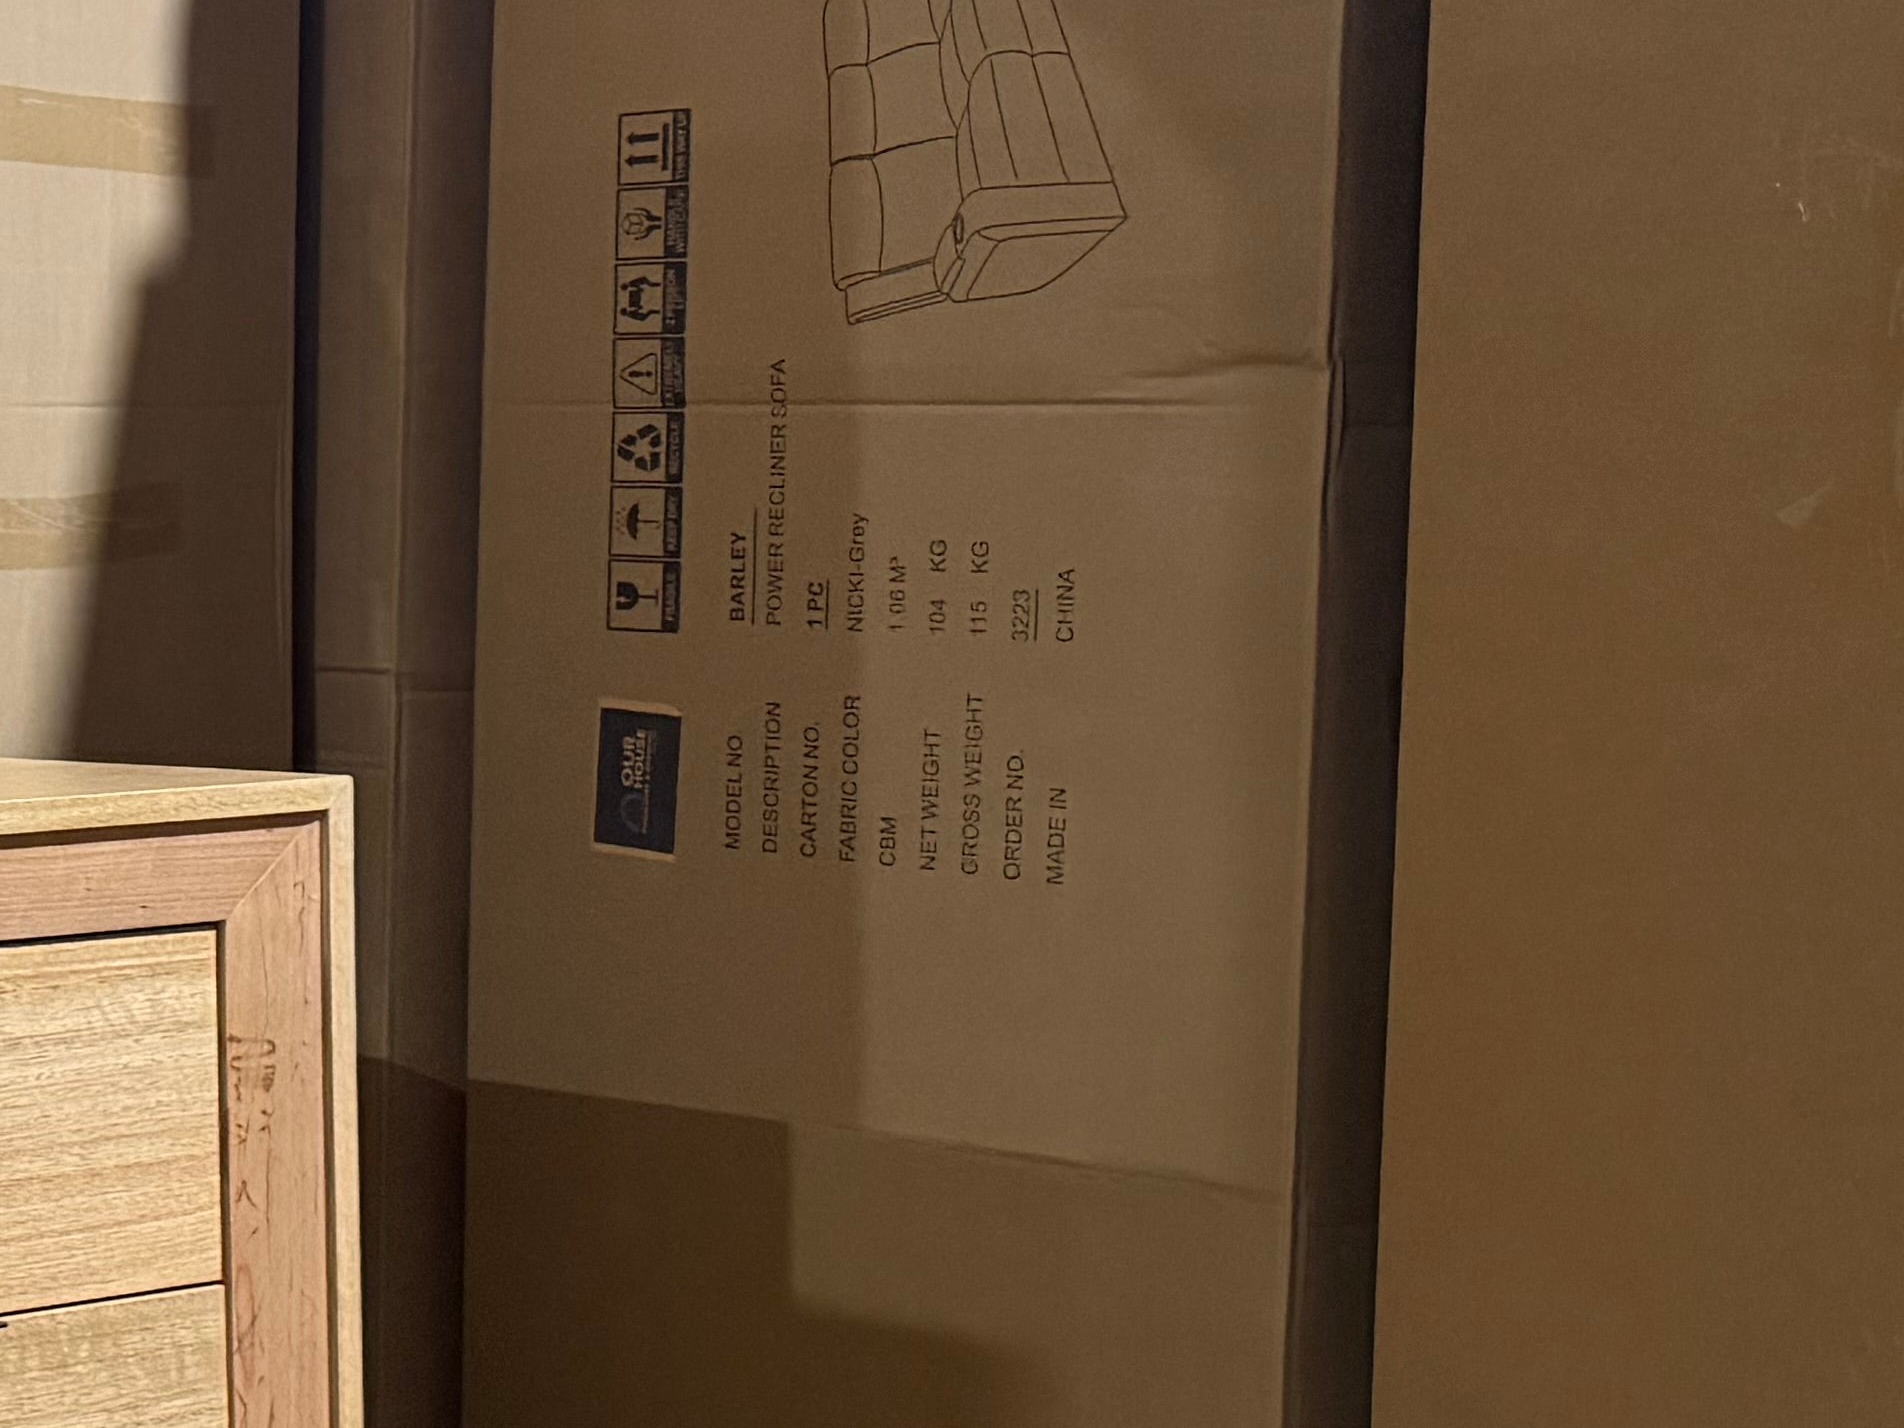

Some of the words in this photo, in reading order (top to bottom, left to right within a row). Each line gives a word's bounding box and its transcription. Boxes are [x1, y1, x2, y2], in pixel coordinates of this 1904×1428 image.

[770, 358, 787, 420] SOFA
[768, 424, 787, 538] RECLINER
[729, 532, 747, 622] BARLEY
[766, 541, 784, 627] POWER
[846, 513, 870, 633] NICKI-Grey
[930, 539, 948, 573] KG
[971, 540, 990, 574] KG
[807, 580, 824, 612] PC
[807, 616, 823, 629] 1
[929, 598, 947, 632] 104
[970, 600, 988, 633] 115
[1056, 568, 1076, 643] CHINA
[620, 735, 636, 788] OUR
[633, 729, 647, 789] HOUSE
[803, 723, 821, 770] NO.
[842, 694, 861, 775] COLOR
[963, 693, 984, 788] WEIGHT
[762, 701, 781, 853] DESCRIPTION
[921, 728, 942, 822] WEIGHT
[1048, 787, 1067, 810] IN
[725, 772, 743, 850] MODEL
[800, 773, 819, 858] CARTON
[839, 780, 858, 863] FABRIC
[878, 816, 897, 867] CBM
[961, 793, 981, 876] GROSS
[1003, 796, 1023, 881] ORDER
[920, 828, 938, 870] NET
[1047, 818, 1067, 886] MADE
